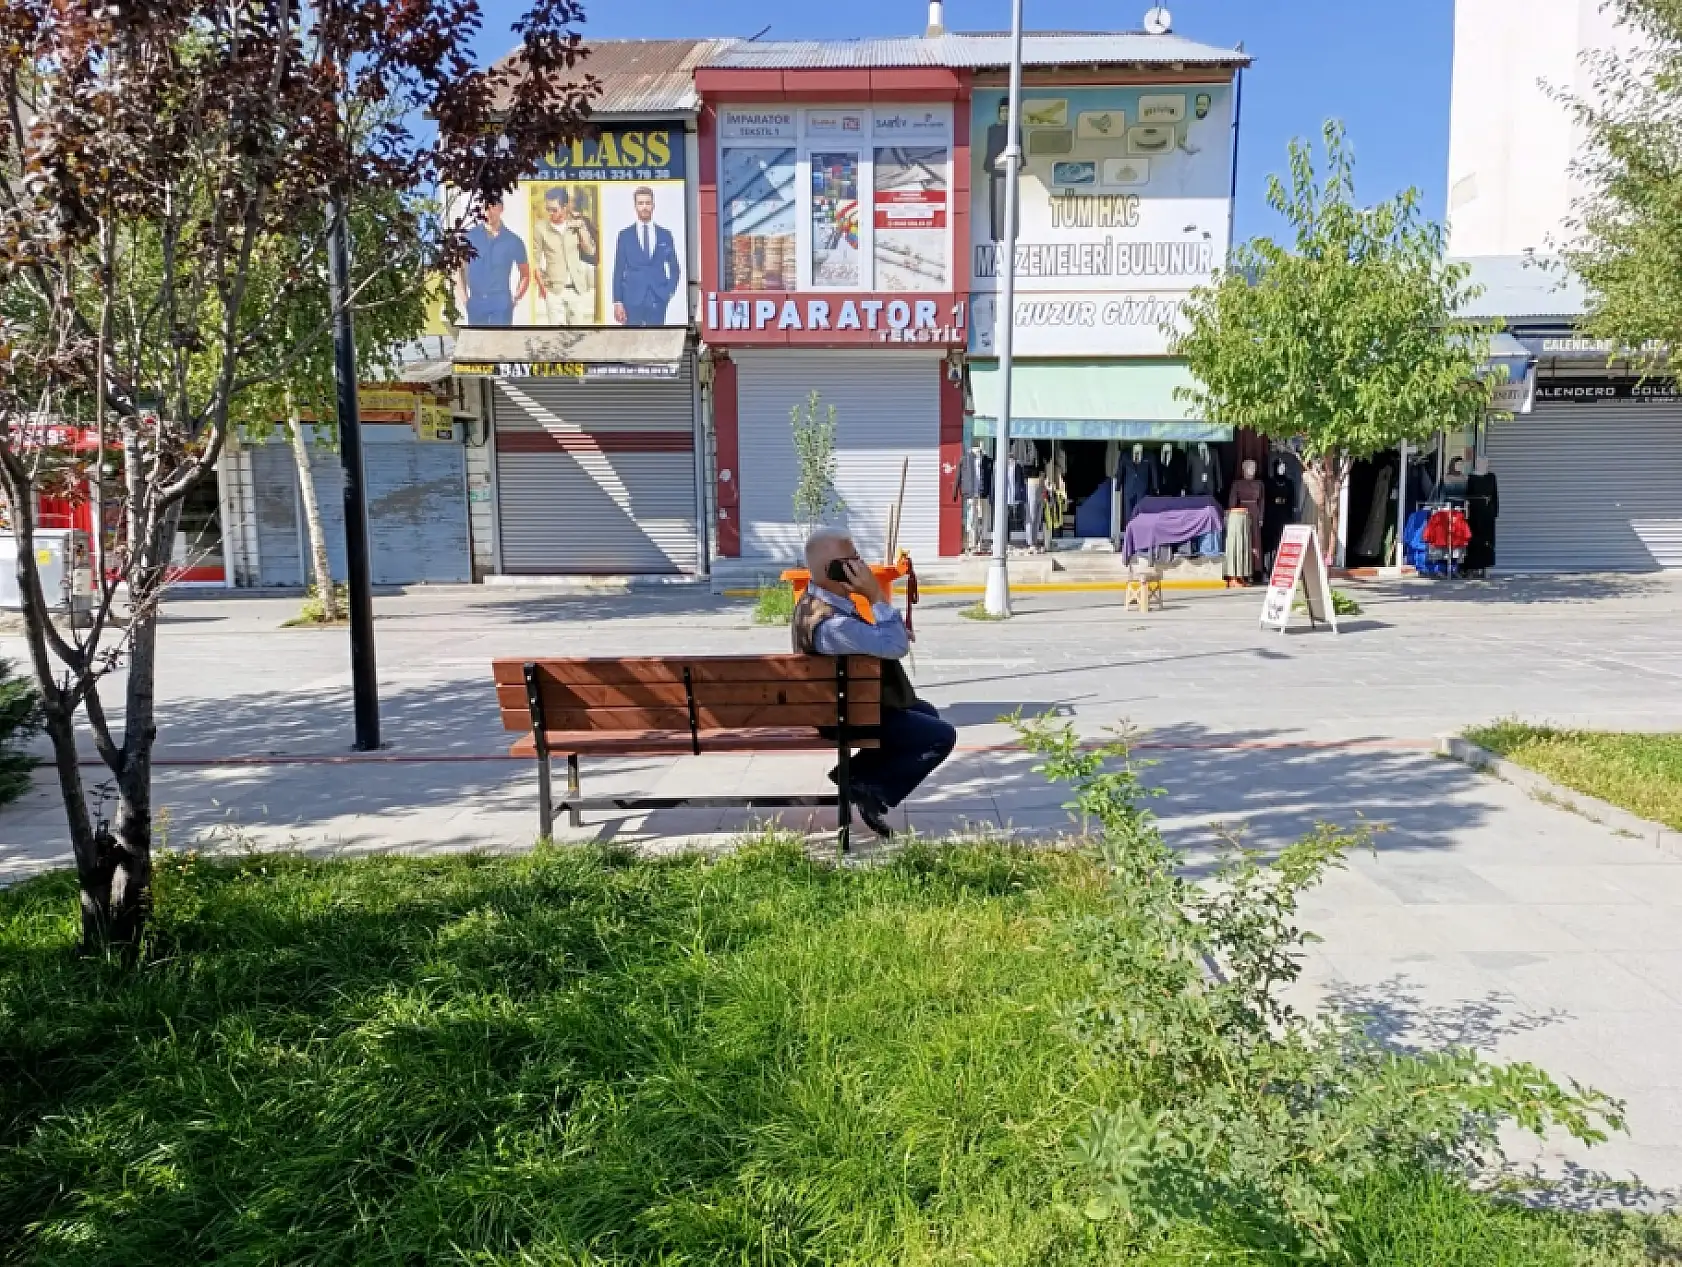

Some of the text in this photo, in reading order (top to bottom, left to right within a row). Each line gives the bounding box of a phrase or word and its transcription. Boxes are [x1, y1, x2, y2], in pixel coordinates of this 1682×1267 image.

[1050, 188, 1093, 228] TÜM
[976, 236, 1214, 278] MAZEMELERİ BULUNUR
[708, 292, 965, 329] İMPARATOR 1
[1015, 296, 1181, 328] HUZUR GİYİM
[879, 325, 961, 342] TEKSTİL
